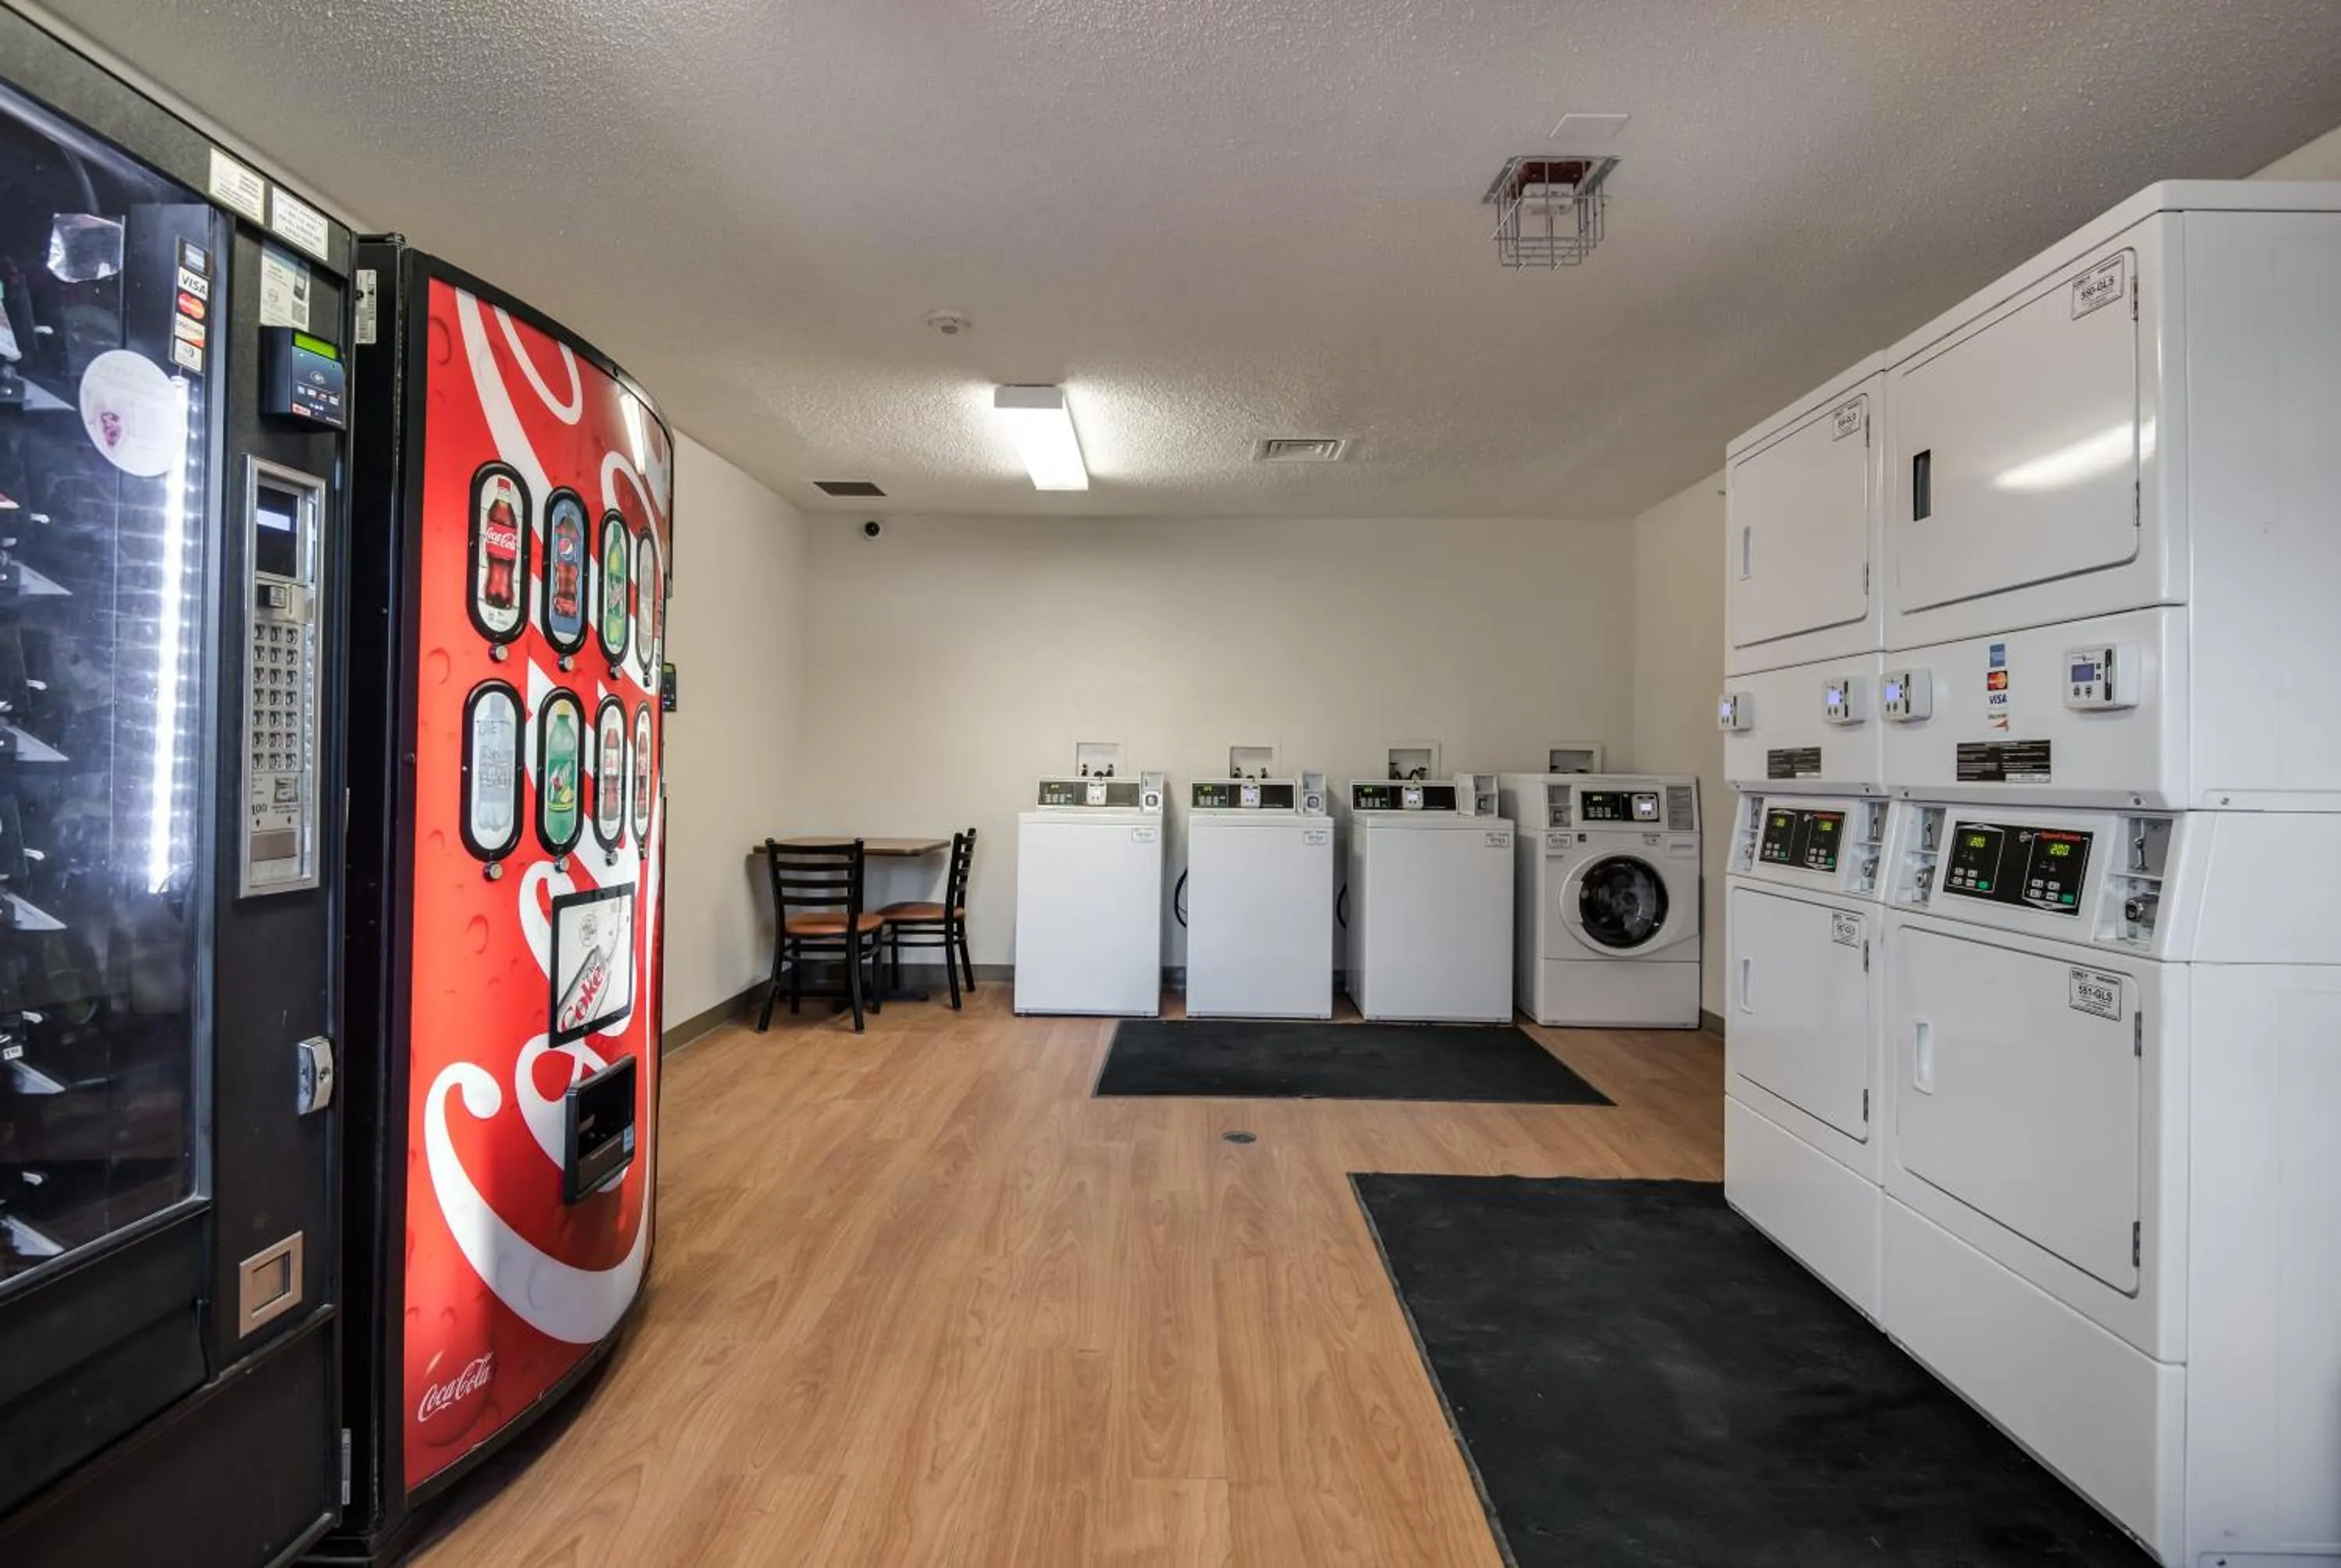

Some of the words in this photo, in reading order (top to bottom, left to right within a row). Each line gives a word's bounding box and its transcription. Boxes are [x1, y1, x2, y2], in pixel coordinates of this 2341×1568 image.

[181, 274, 206, 295] VISA
[1989, 694, 2008, 704] VISA
[417, 1351, 494, 1423] Coca-Cola
